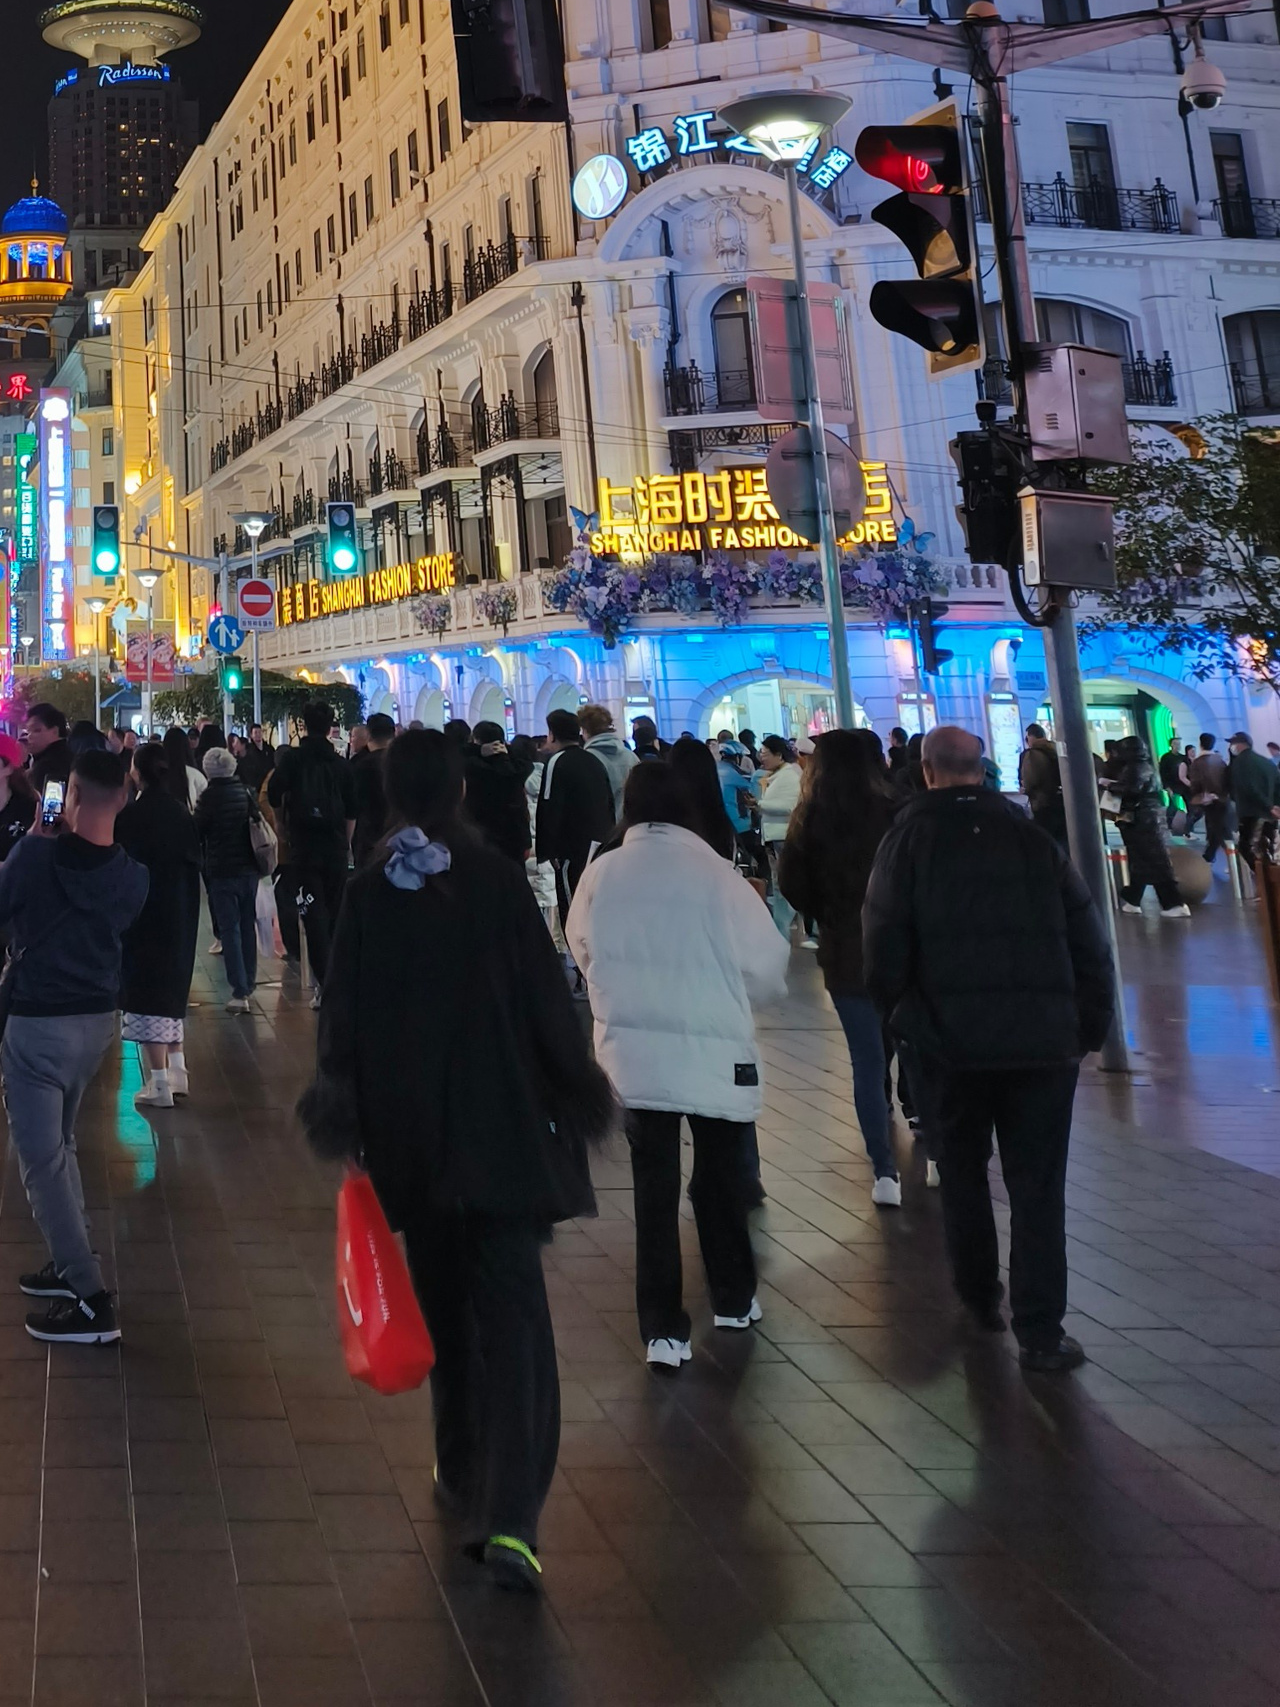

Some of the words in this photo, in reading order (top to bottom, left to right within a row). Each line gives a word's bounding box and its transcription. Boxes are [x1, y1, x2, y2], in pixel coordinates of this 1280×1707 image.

[99, 61, 162, 87] Radisson
[598, 461, 893, 527] 上海时装店
[590, 529, 703, 554] SHANGHAI
[321, 575, 364, 614] SHANGHAI
[369, 562, 412, 603] FASHION
[418, 552, 456, 593] STORE
